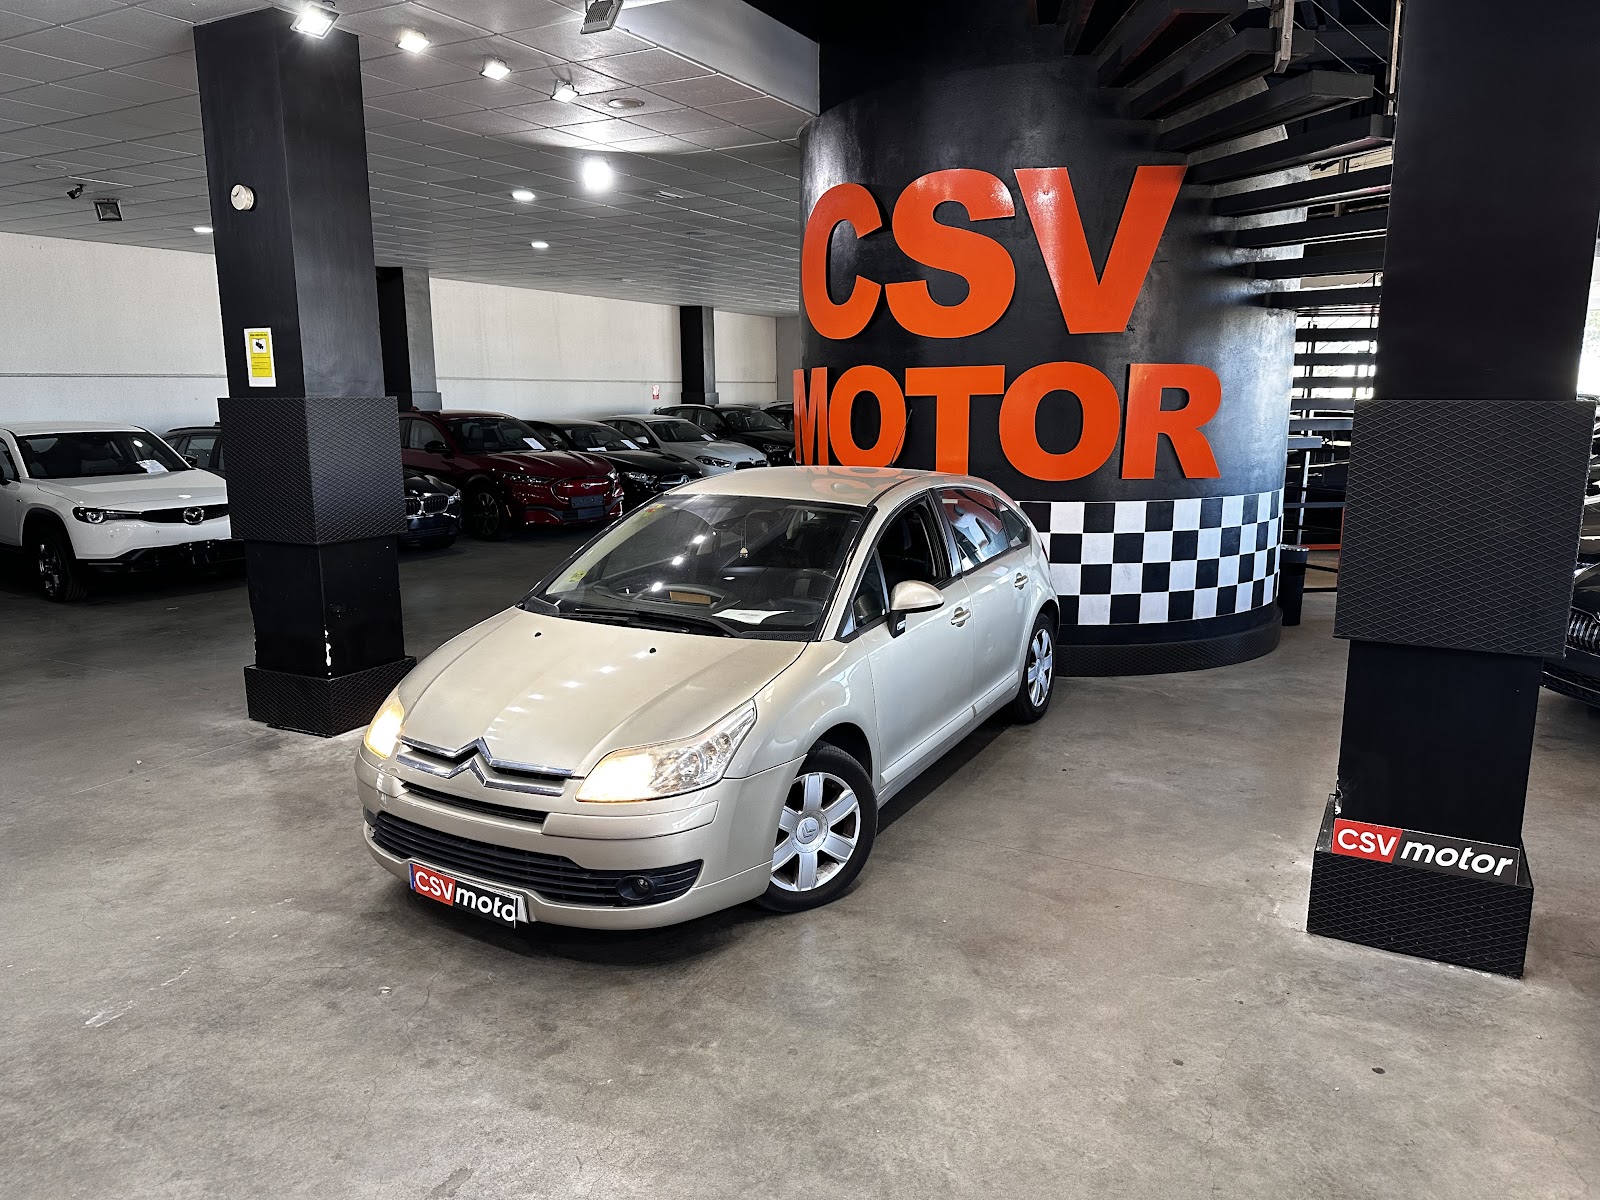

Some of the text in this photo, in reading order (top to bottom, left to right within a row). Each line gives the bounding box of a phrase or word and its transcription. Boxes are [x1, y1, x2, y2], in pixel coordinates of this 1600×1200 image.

[802, 165, 1188, 340] CSV
[793, 362, 1222, 481] MOTOR
[1337, 828, 1513, 877] CSV motor
[415, 871, 516, 922] CSV moto
